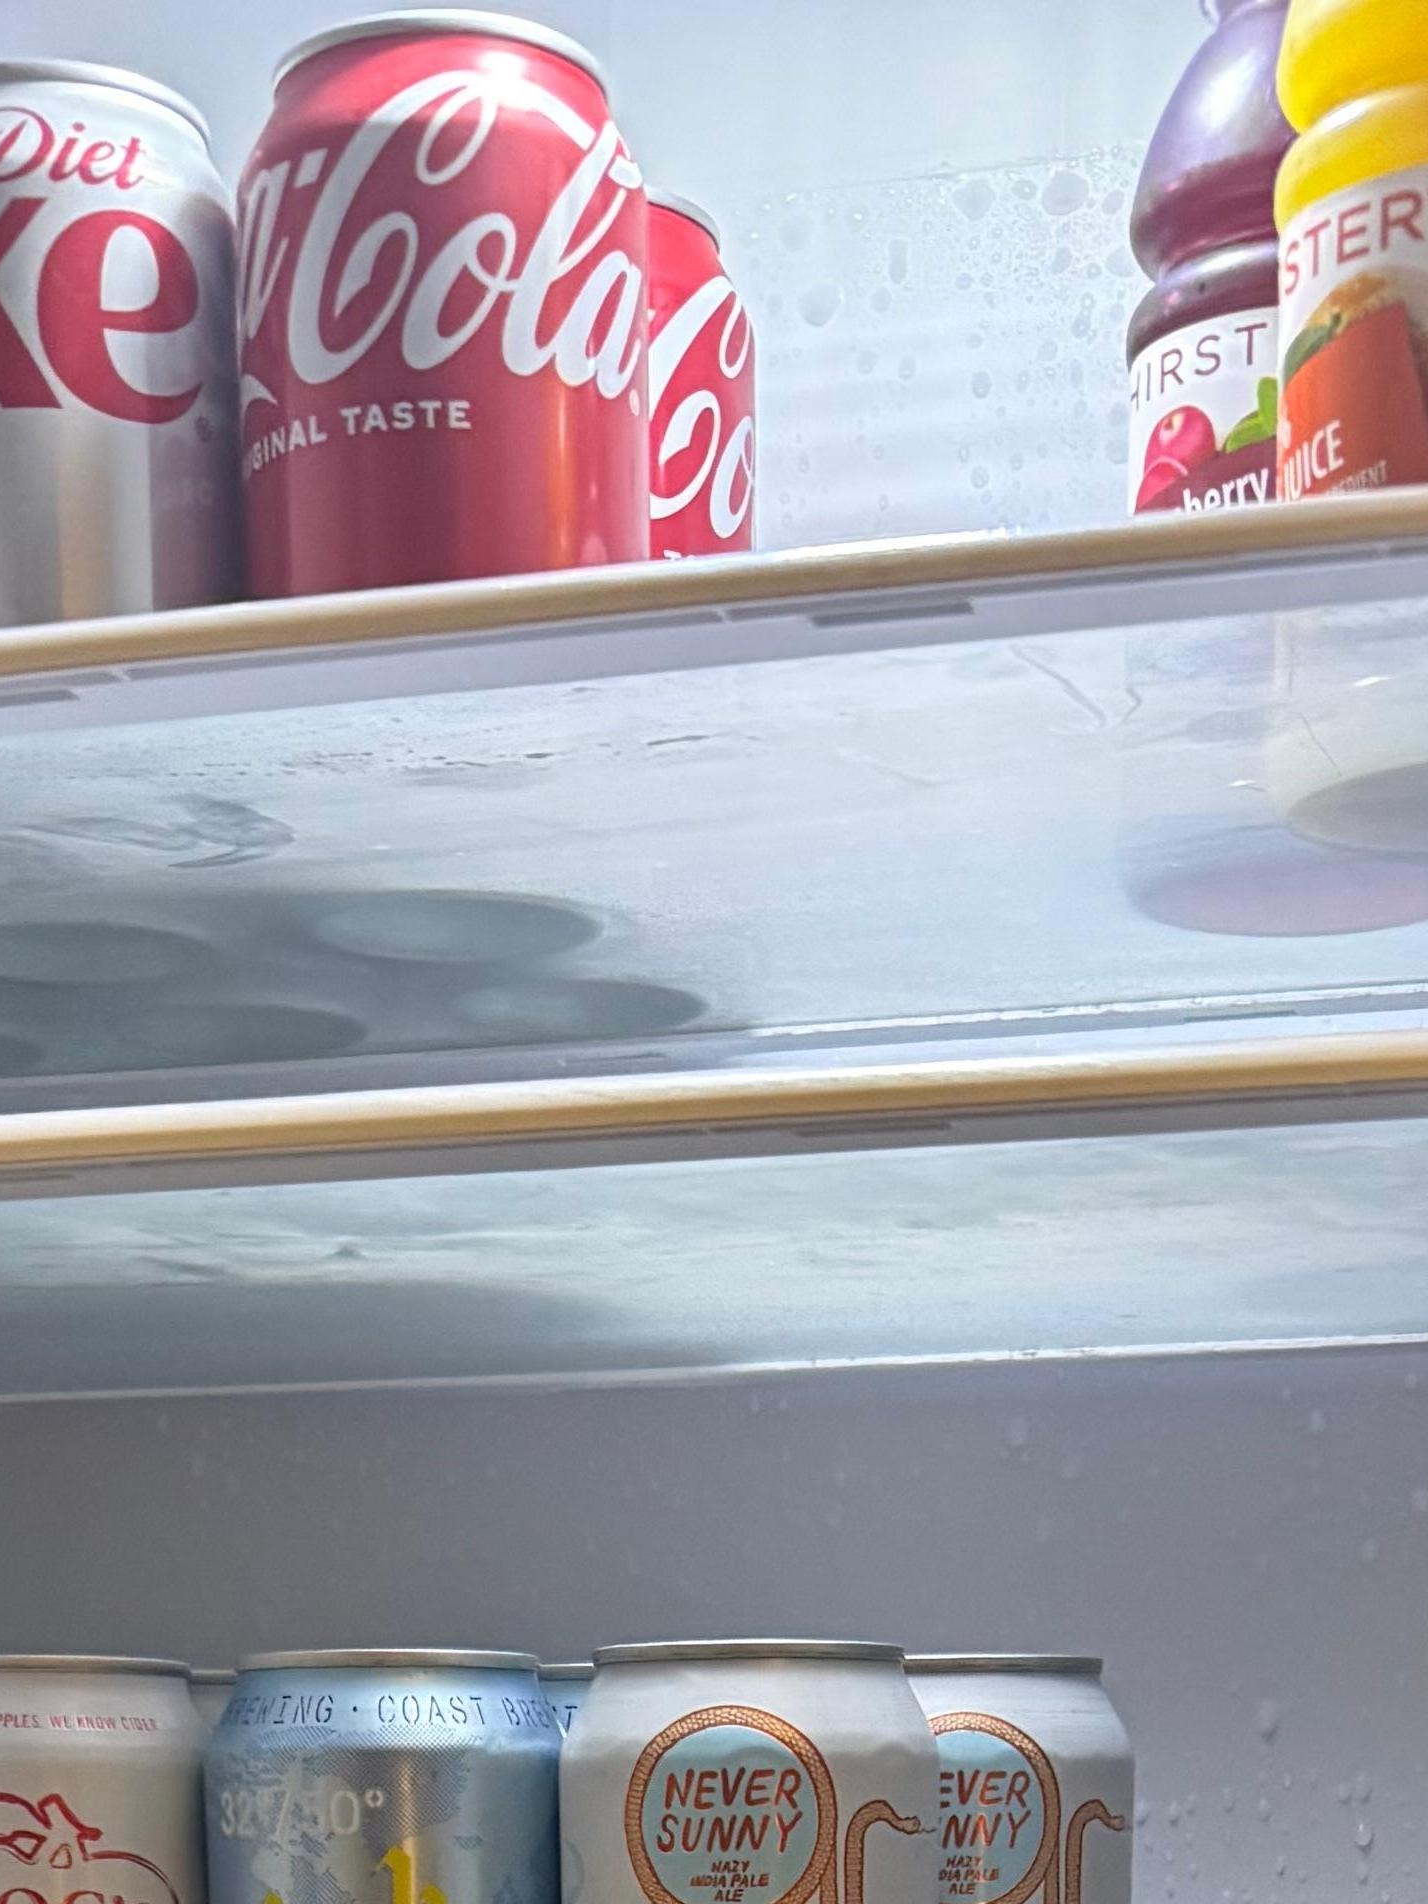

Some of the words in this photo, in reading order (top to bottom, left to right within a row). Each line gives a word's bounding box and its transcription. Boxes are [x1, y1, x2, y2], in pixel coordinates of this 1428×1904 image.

[340, 399, 473, 437] TASTE
[377, 1694, 487, 1726] COAST
[662, 1766, 803, 1811] NEVER
[939, 1768, 1031, 1809] EVER
[656, 1810, 804, 1854] SUNNY
[940, 1809, 1032, 1850] NNY
[689, 1873, 727, 1889] INDIA
[729, 1872, 769, 1889] PALE
[710, 1859, 750, 1875] HAZY
[712, 1888, 746, 1903] ALE
[948, 1882, 977, 1896] ALE
